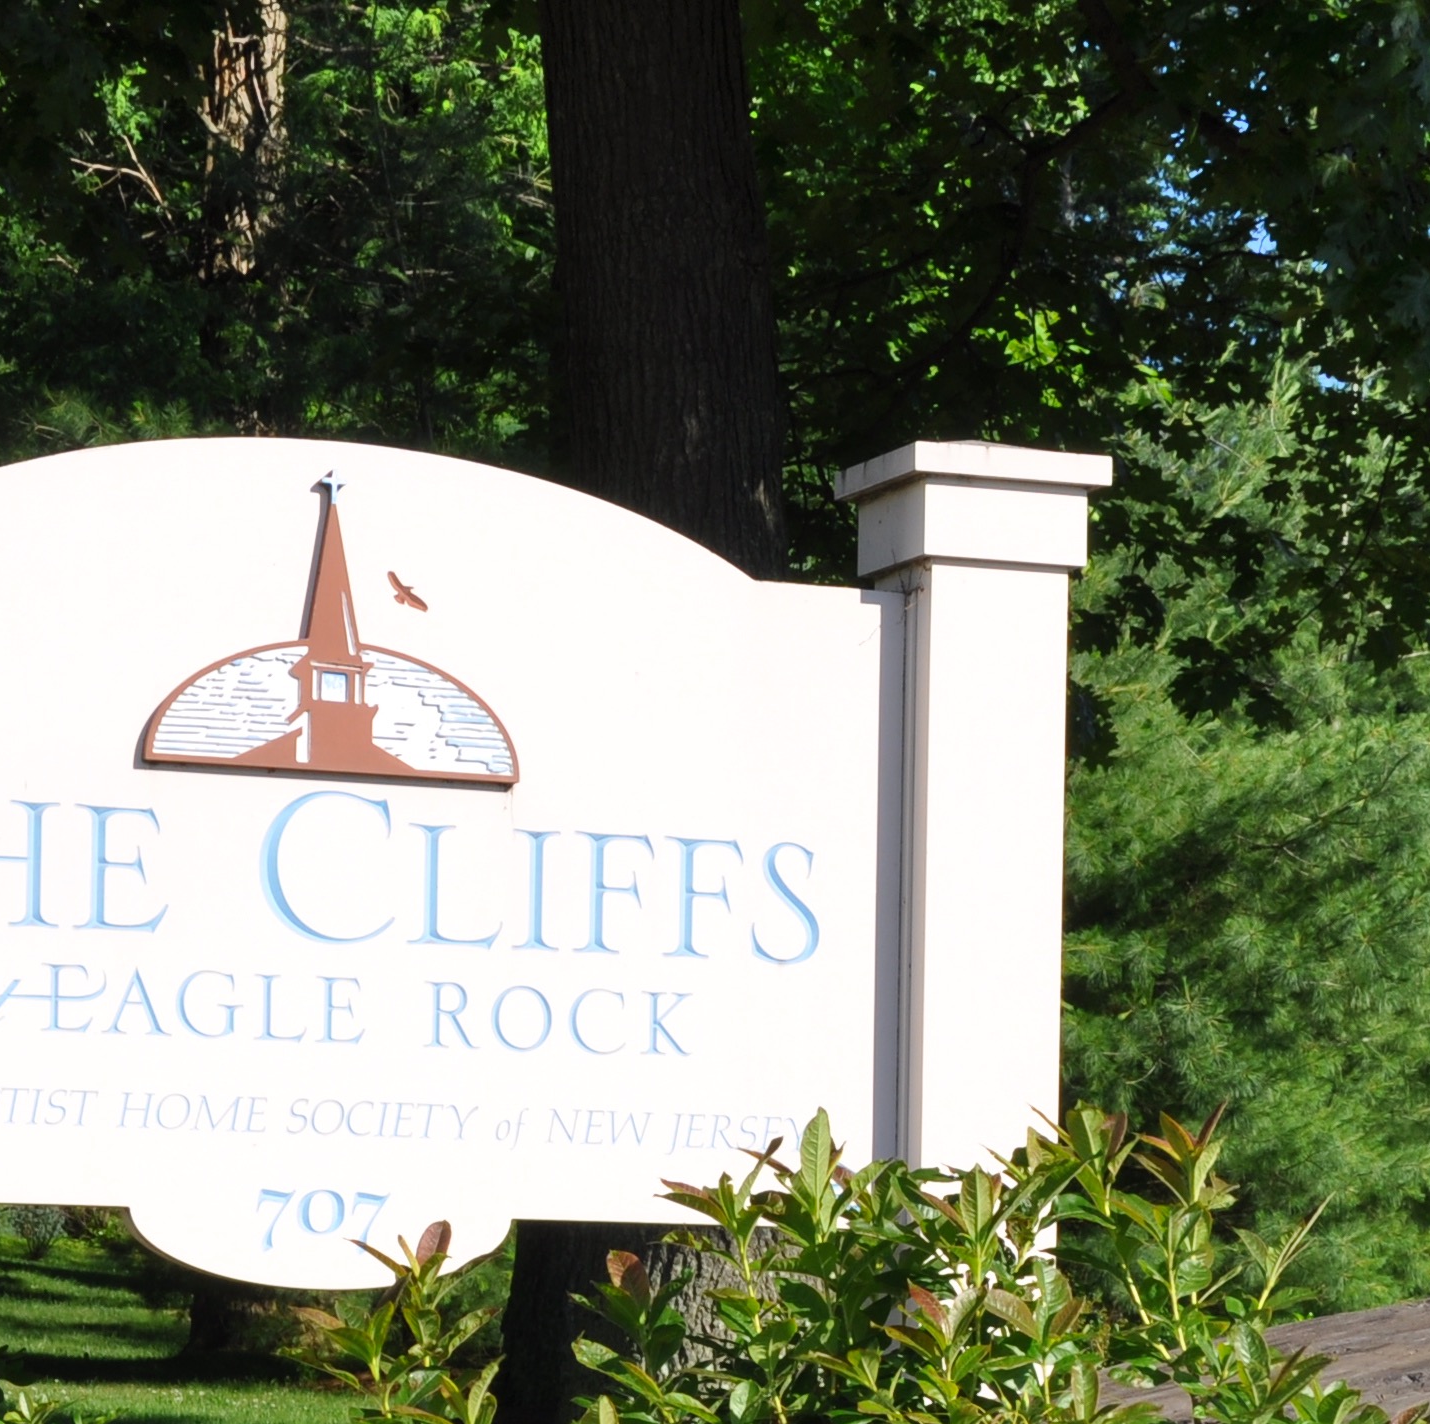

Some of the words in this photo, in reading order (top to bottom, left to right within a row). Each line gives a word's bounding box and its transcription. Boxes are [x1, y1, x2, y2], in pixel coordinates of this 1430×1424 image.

[258, 789, 821, 966] CLIFFS
[40, 962, 367, 1046] EAGLE
[423, 980, 694, 1057] ROCK
[116, 1092, 269, 1134] HOME
[285, 1098, 479, 1141] SOCIETY
[494, 1107, 530, 1152] of
[546, 1108, 654, 1147] NEW
[256, 1188, 392, 1256] 707
